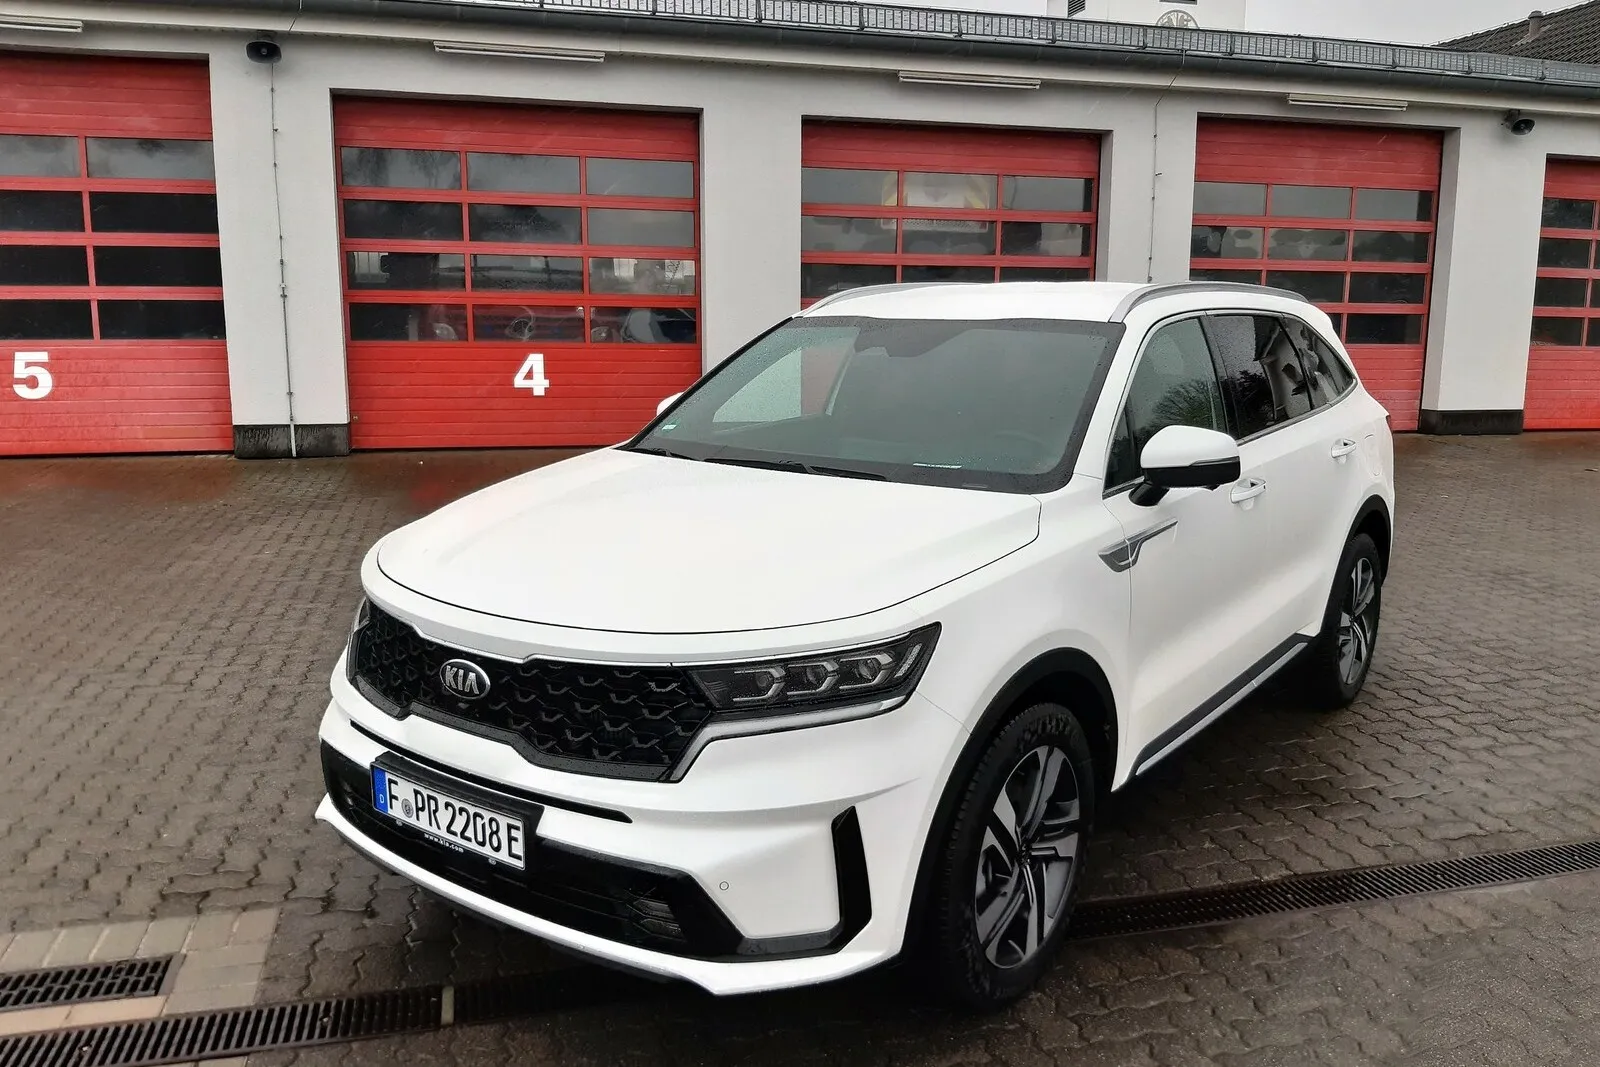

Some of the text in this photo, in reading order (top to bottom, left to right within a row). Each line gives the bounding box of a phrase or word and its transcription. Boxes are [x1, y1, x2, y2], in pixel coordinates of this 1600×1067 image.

[13, 351, 53, 400] 5
[514, 353, 550, 396] 4
[445, 665, 480, 694] KIA
[387, 778, 399, 810] F
[413, 788, 441, 830] PR
[424, 833, 464, 853] www.kia.com
